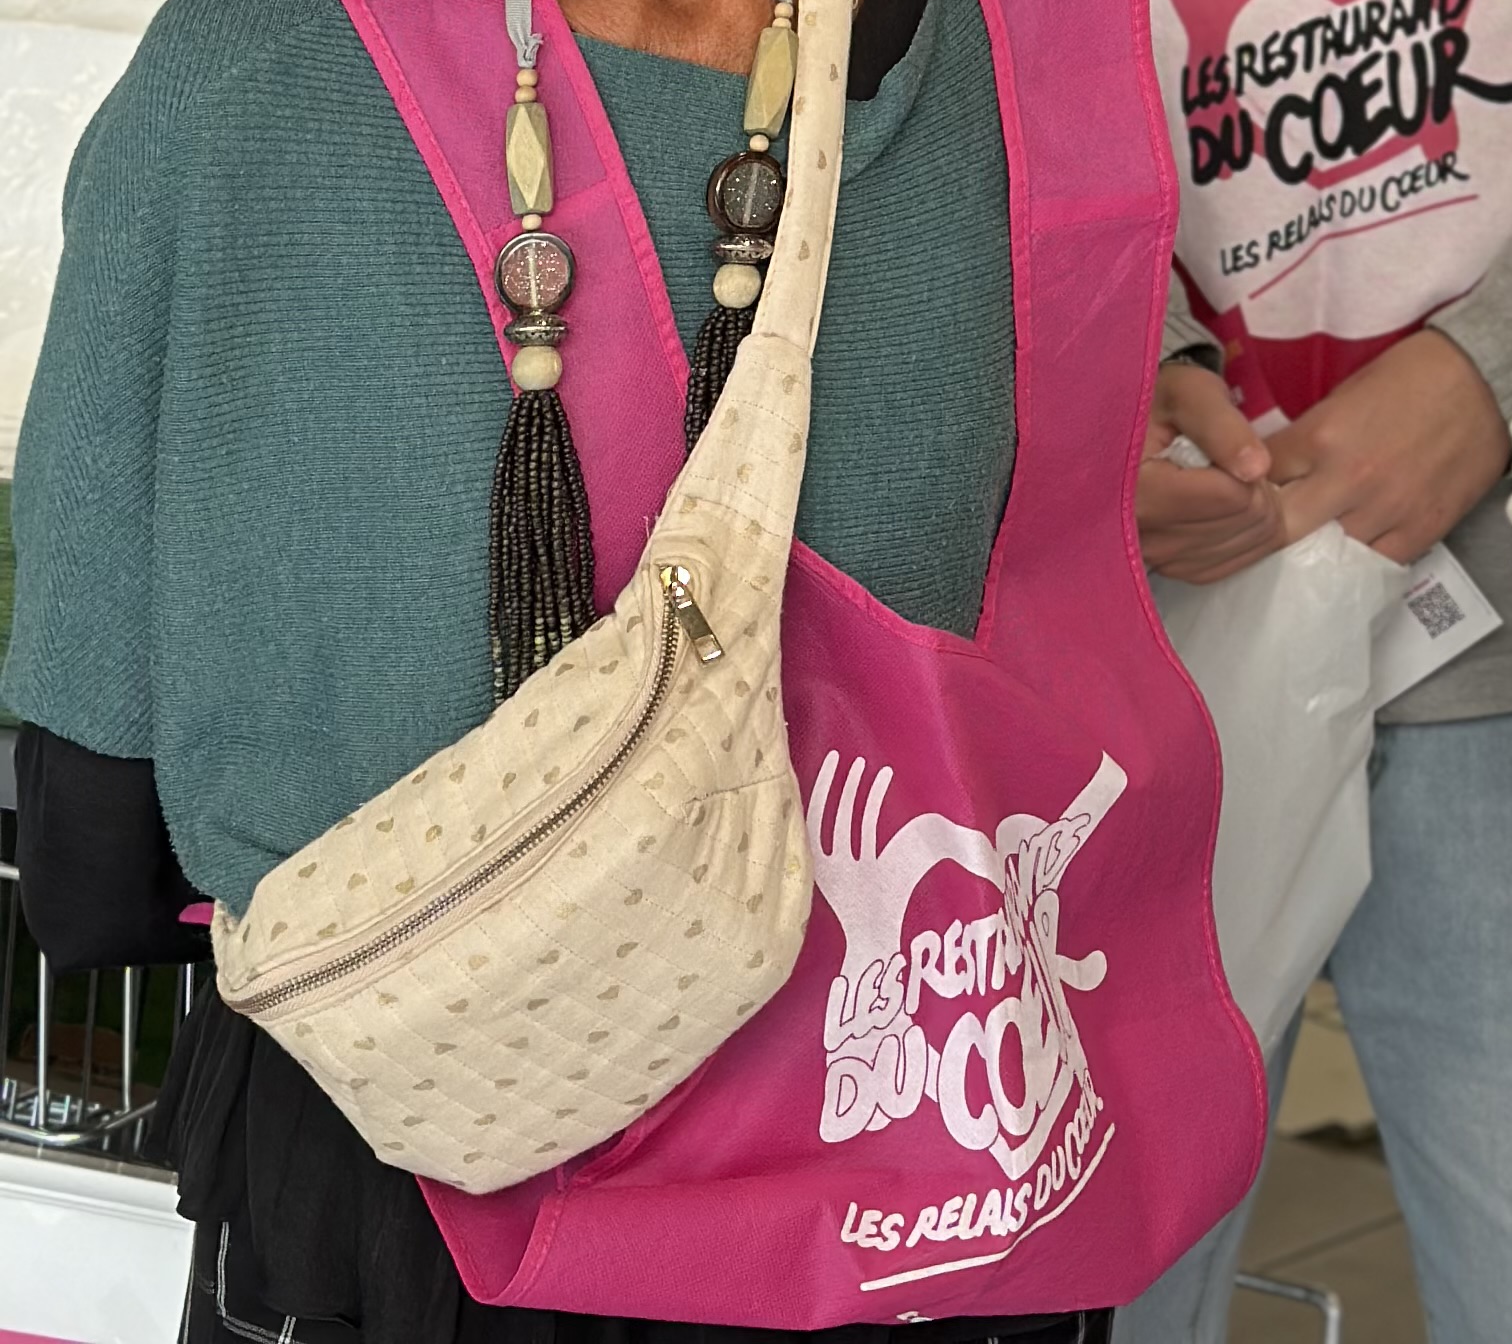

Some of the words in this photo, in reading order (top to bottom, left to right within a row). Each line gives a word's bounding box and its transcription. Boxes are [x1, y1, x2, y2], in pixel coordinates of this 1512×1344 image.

[1180, 56, 1230, 116] LES
[1189, 109, 1254, 186] DU
[1220, 240, 1260, 277] LES
[1266, 191, 1335, 261] RELAIS
[1340, 178, 1376, 219] DU
[824, 951, 908, 1053] LES
[819, 1025, 929, 1143] DU
[840, 1202, 905, 1251] LES
[906, 1182, 1033, 1248] RELAIS
[1034, 1159, 1066, 1211] DU
